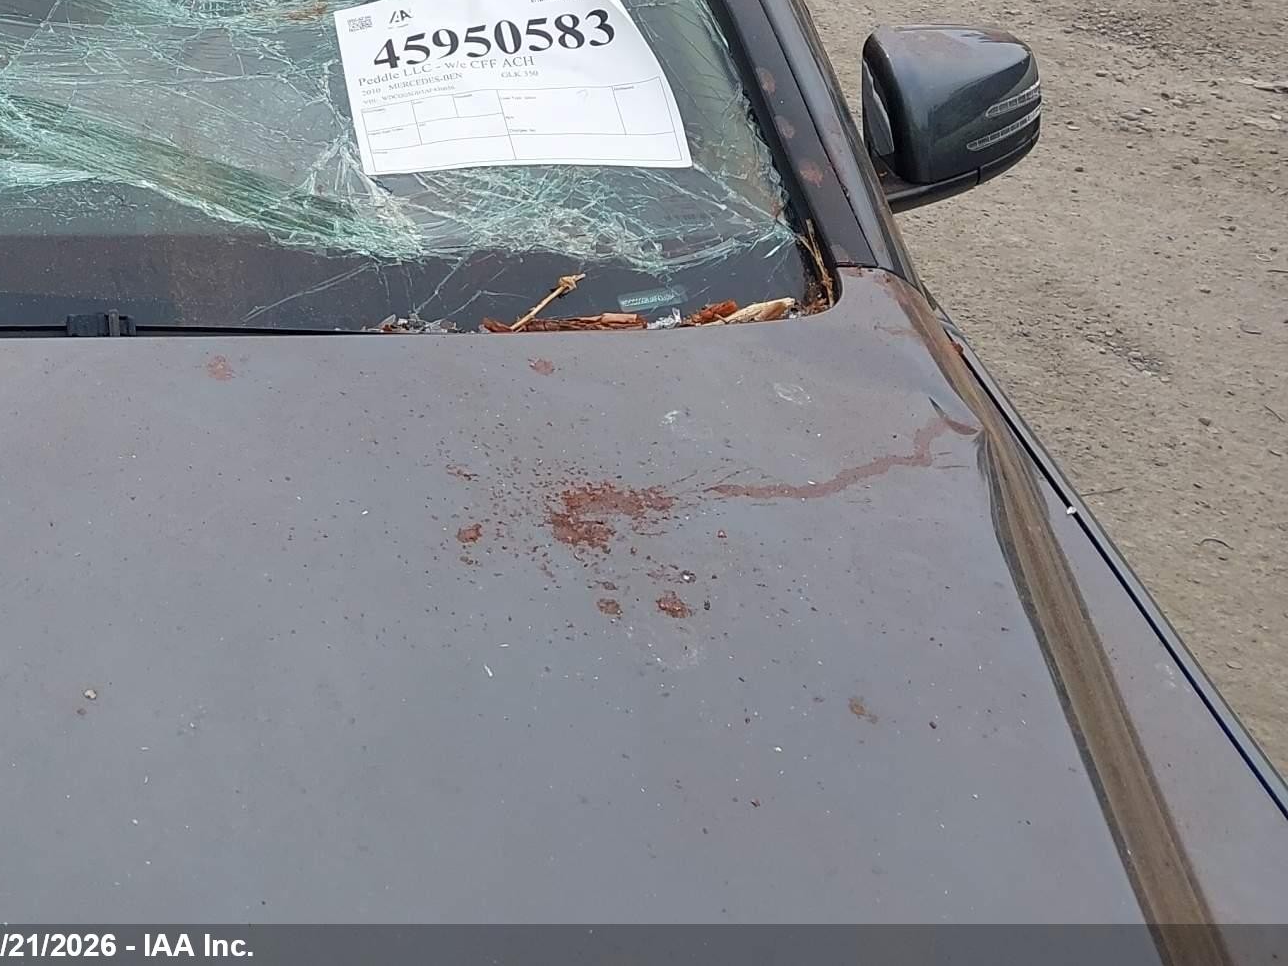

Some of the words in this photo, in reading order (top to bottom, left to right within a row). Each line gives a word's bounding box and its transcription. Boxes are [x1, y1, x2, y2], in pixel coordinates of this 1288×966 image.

[373, 8, 615, 69] 45950583
[358, 72, 400, 87] Peddle
[403, 62, 434, 77] LLC
[469, 58, 497, 70] CFF
[502, 55, 536, 68] ACH
[388, 72, 464, 91] MERCEDES-BEN
[500, 70, 522, 78] GLK
[523, 69, 540, 78] 350
